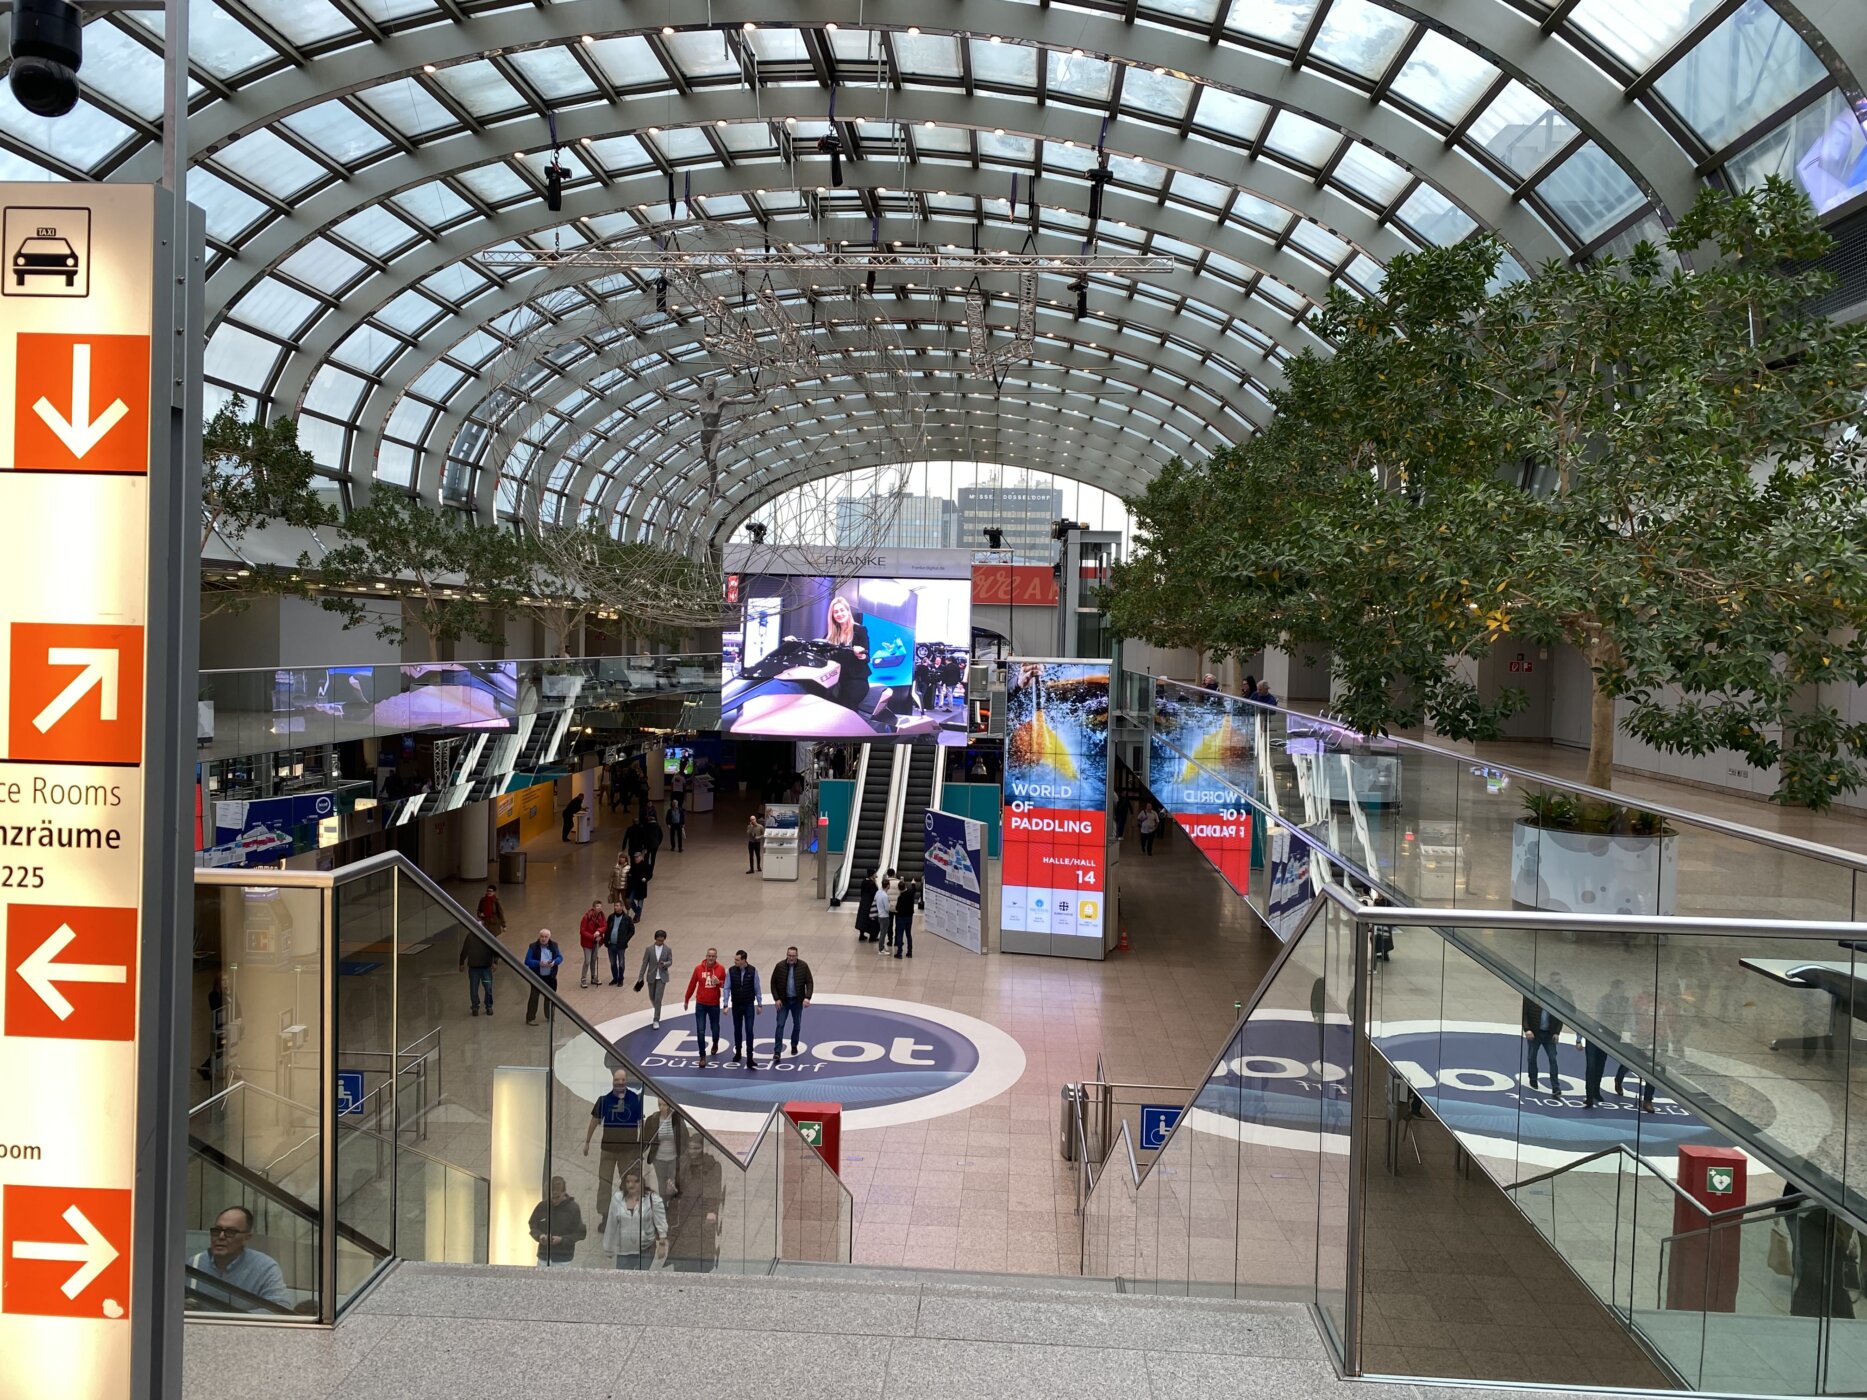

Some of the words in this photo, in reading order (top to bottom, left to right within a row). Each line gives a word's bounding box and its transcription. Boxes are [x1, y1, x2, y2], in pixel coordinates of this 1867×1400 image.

[38, 228, 55, 236] TAXI
[825, 555, 887, 566] FRANKE
[33, 777, 122, 806] Rooms
[1012, 783, 1072, 798] WORLD
[1012, 801, 1034, 813] OF
[1011, 817, 1092, 834] PADDLING
[1043, 856, 1096, 867] HALLE/HALL
[1, 866, 44, 888] 225
[1076, 871, 1096, 885] 14
[651, 1029, 936, 1066] boot
[0, 1144, 41, 1159] oom
